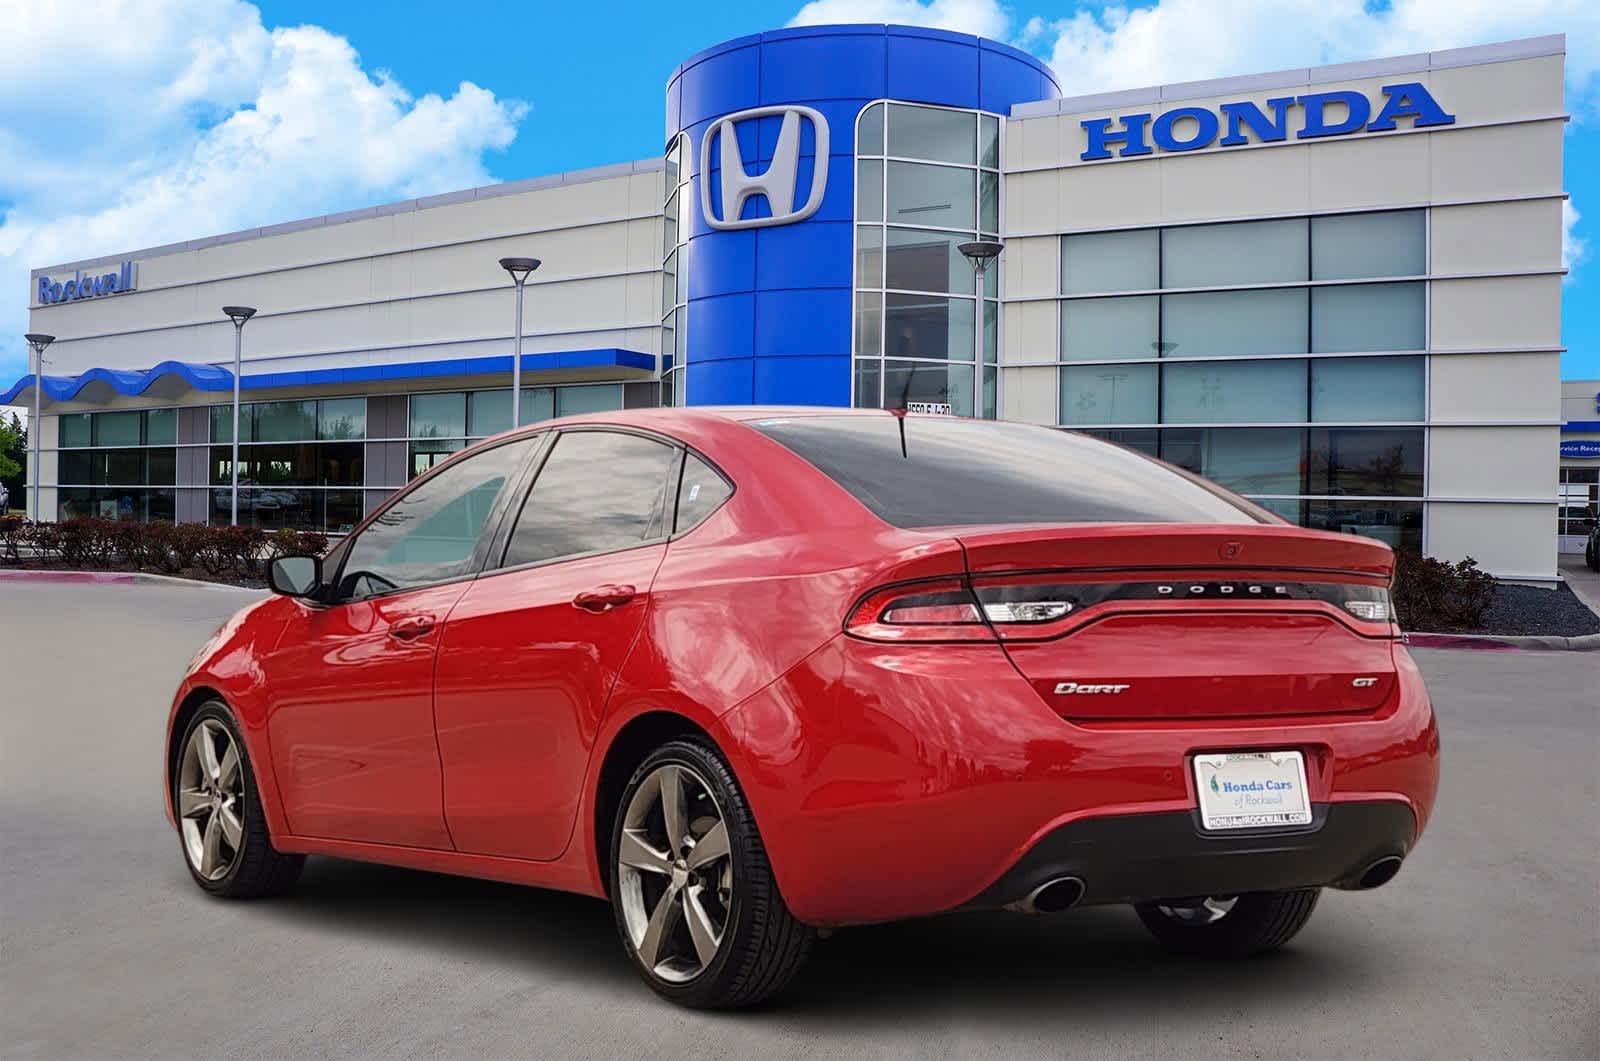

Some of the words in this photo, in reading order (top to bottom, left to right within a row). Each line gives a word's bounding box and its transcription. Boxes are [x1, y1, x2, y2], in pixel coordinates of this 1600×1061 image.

[1080, 82, 1456, 161] HONDA
[38, 261, 132, 304] Rockwall
[1157, 585, 1286, 594] DODGE
[1352, 677, 1379, 687] GT
[1223, 781, 1264, 793] Honda
[1266, 780, 1293, 791] Cars
